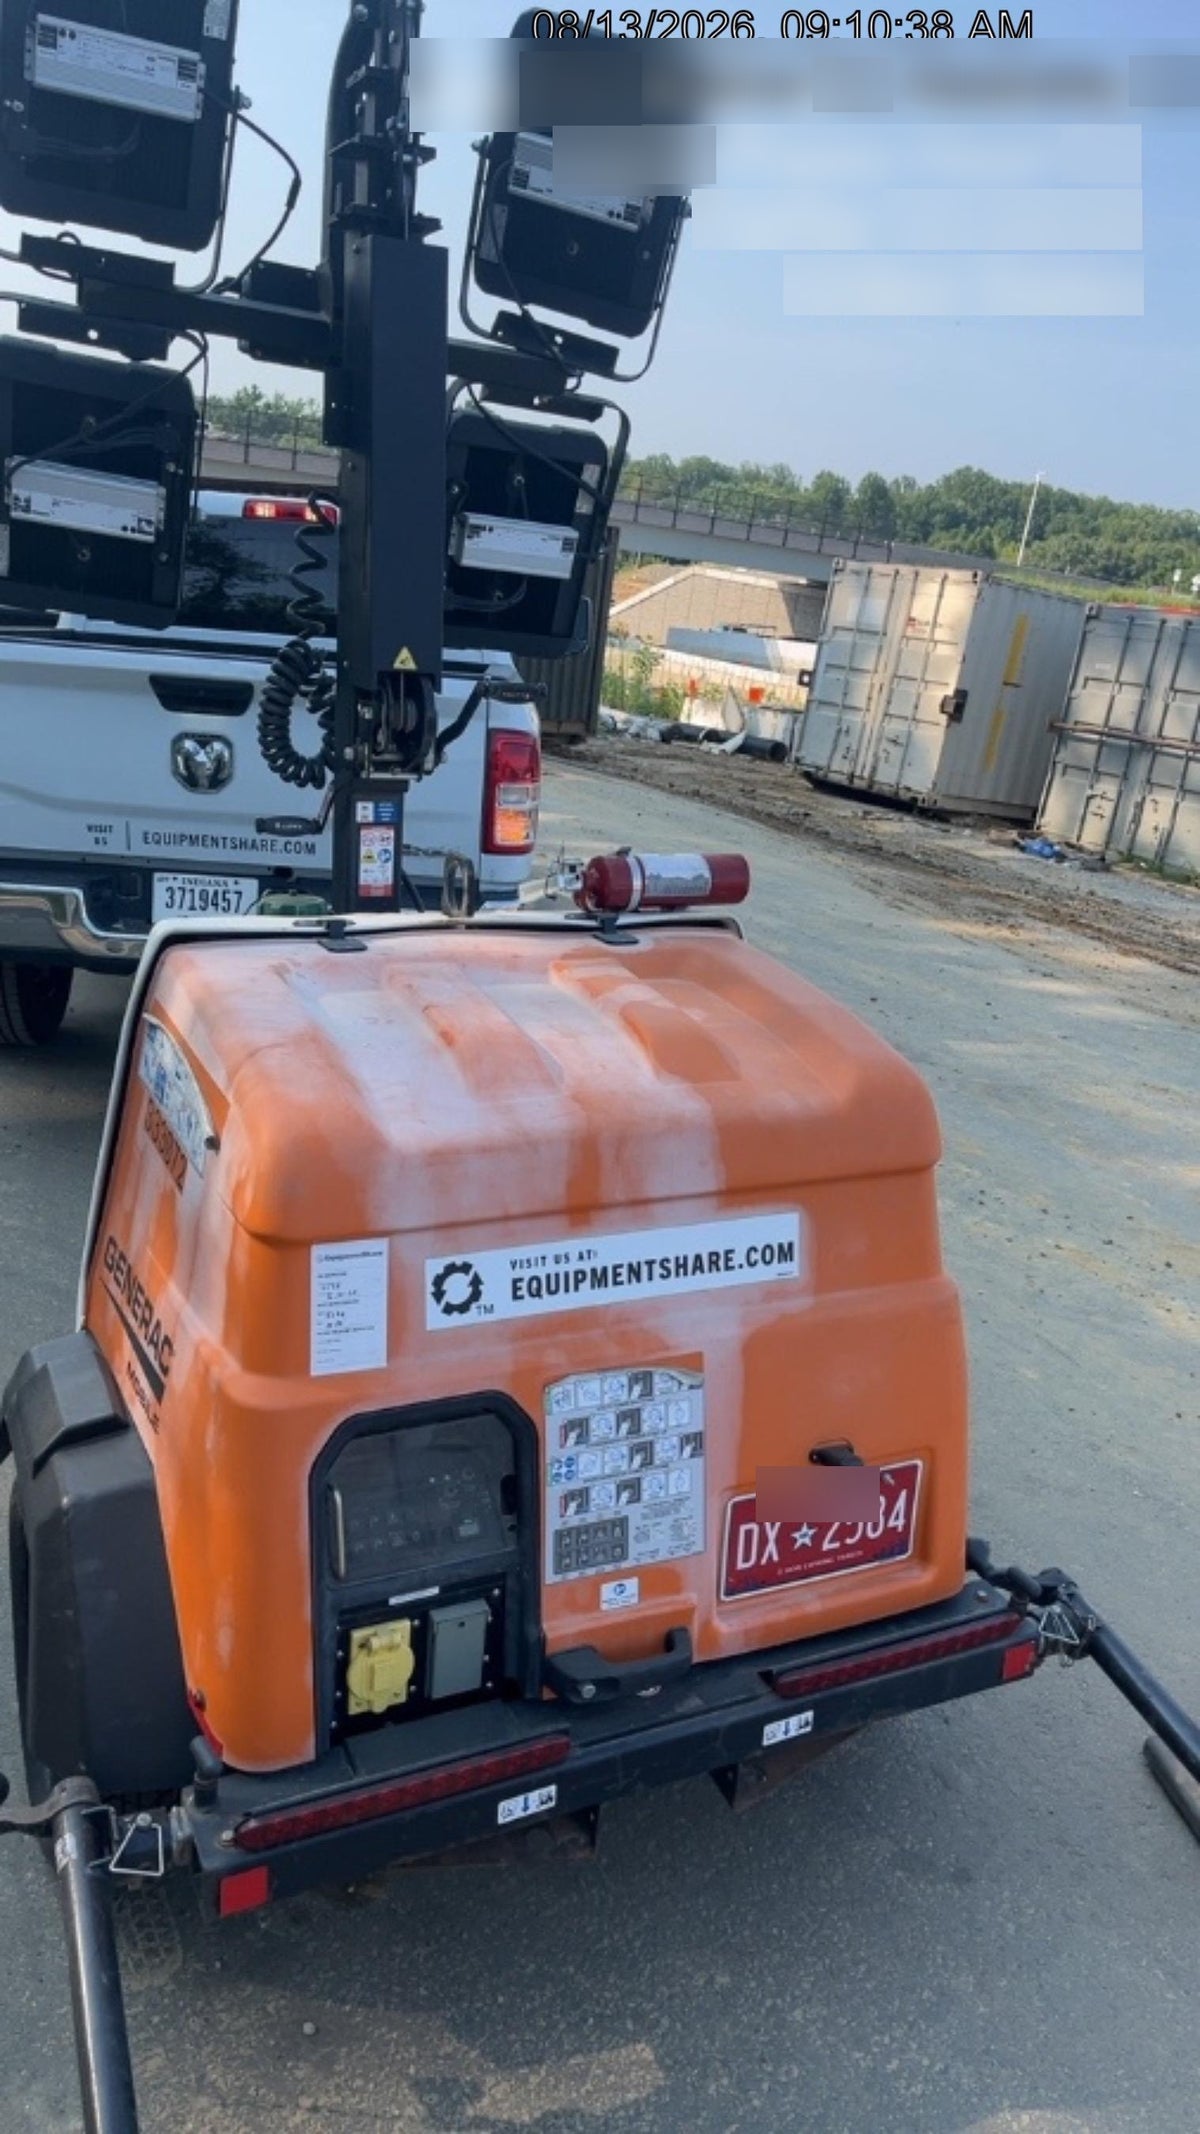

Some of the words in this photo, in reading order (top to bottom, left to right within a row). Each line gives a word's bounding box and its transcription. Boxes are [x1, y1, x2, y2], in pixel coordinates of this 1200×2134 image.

[142, 831, 317, 856] EQUIPMENTSHARE.COM
[165, 886, 243, 914] 3719457
[509, 1254, 548, 1271] VISIT
[553, 1251, 572, 1265] US
[511, 1241, 795, 1302] EQUIPMENTSHARE.COM
[104, 1235, 175, 1379] GENERAC
[475, 1303, 495, 1316] TM
[735, 1521, 781, 1571] DX
